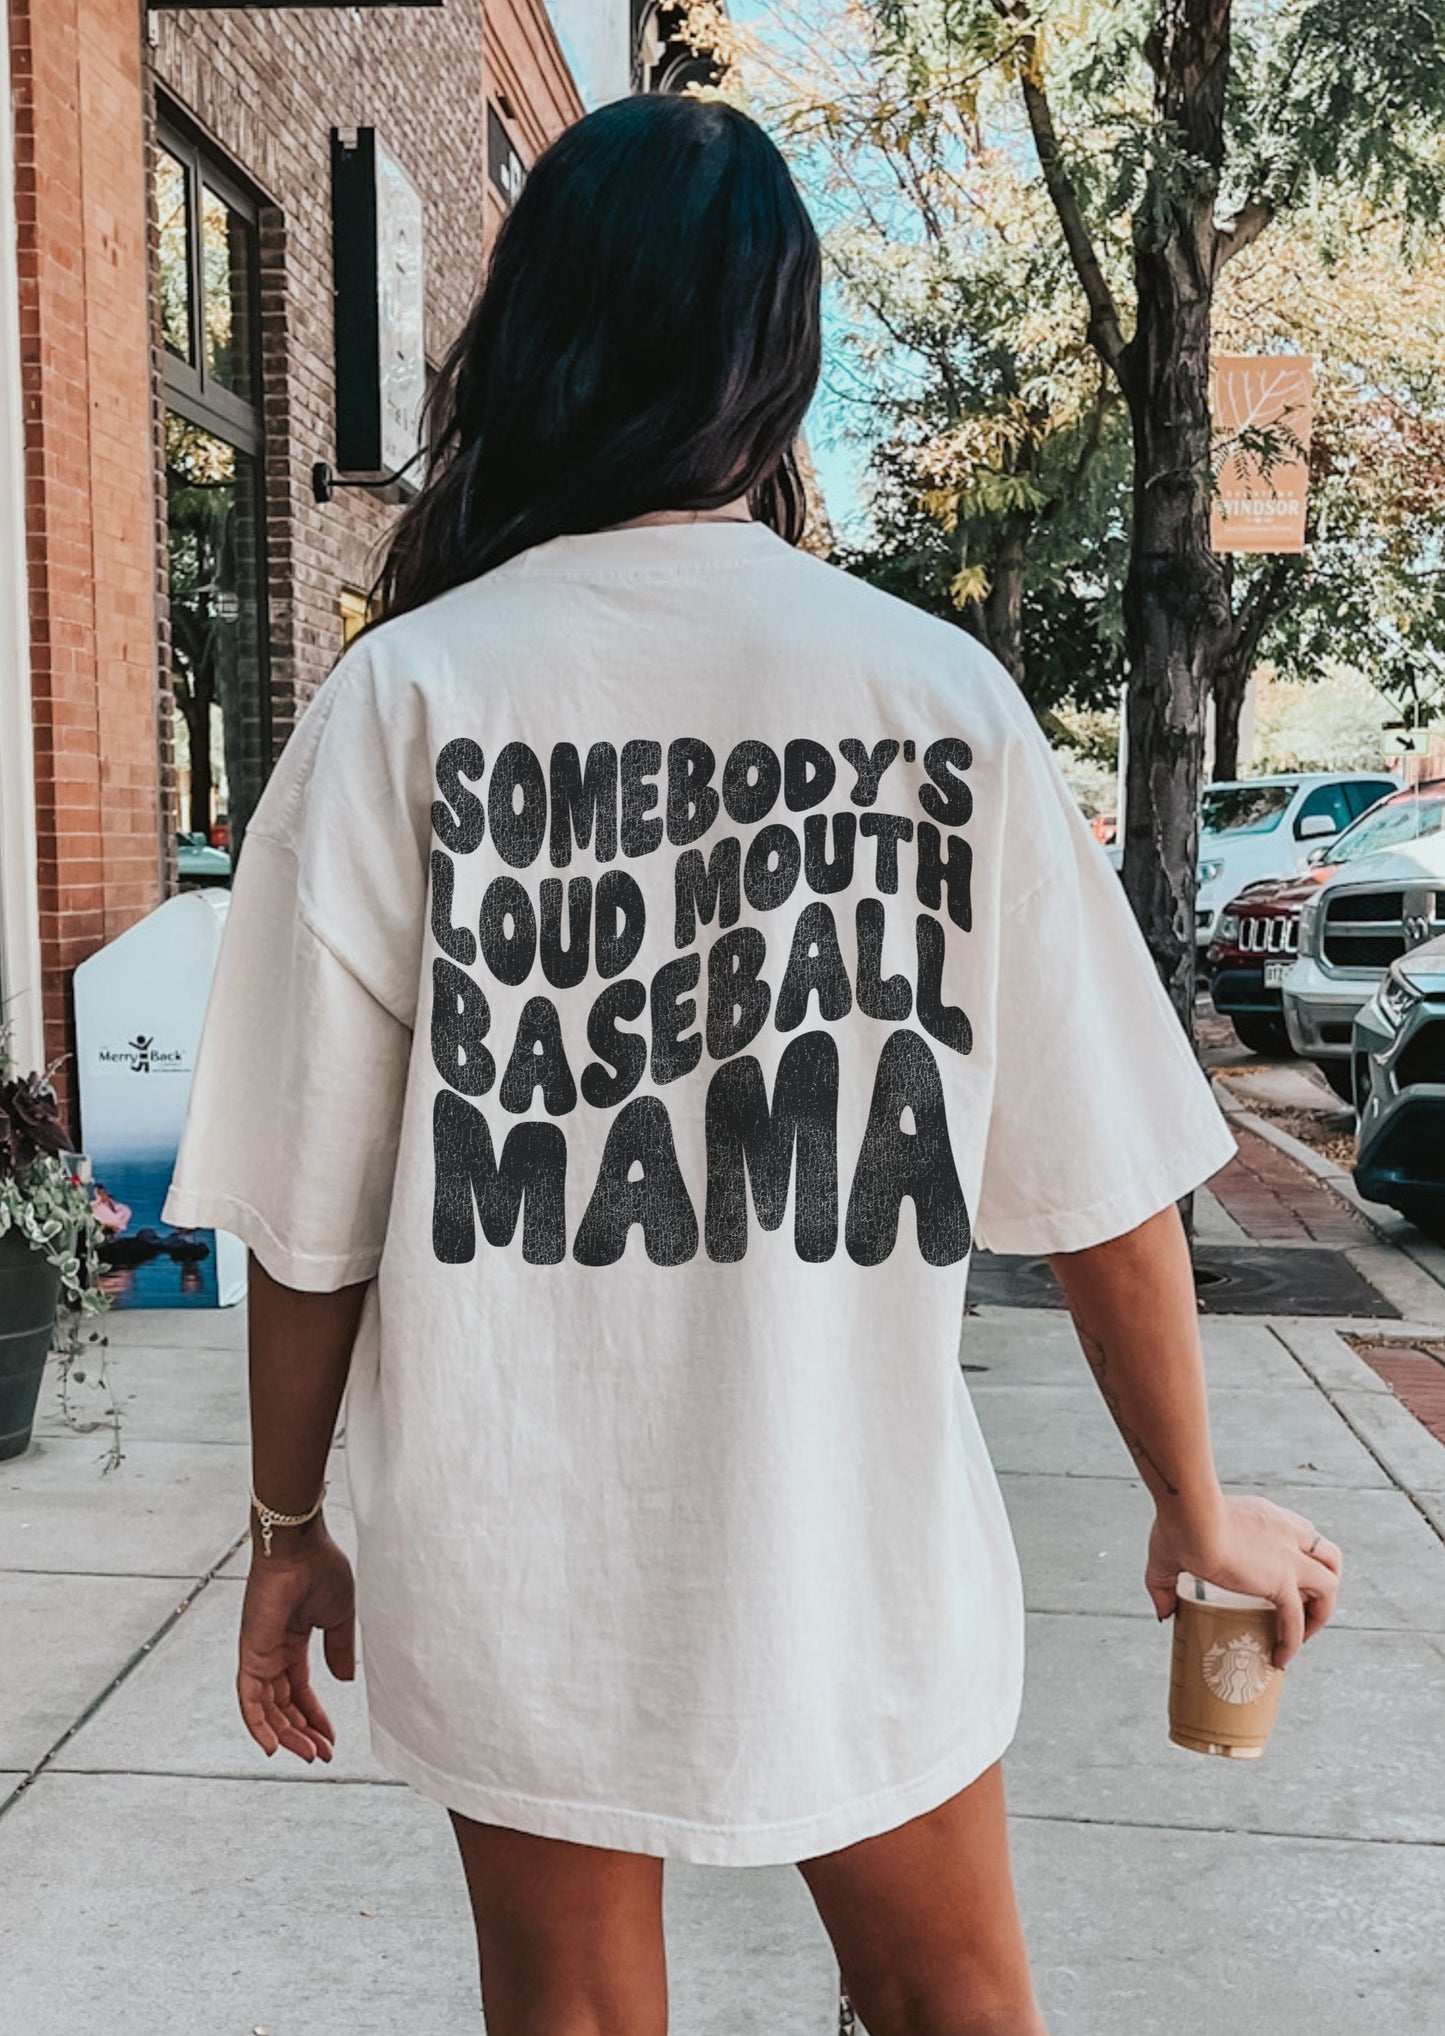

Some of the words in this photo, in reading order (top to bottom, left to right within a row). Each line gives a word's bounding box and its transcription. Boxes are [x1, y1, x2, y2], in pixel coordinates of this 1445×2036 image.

[431, 738, 973, 868] SOMEBODY'S
[431, 848, 646, 990] LOUD
[674, 812, 973, 949] MOUTH
[98, 1050, 138, 1063] Merry
[150, 1050, 182, 1062] Back
[431, 897, 973, 1116] BASEBALL
[432, 1029, 971, 1267] MAMA
